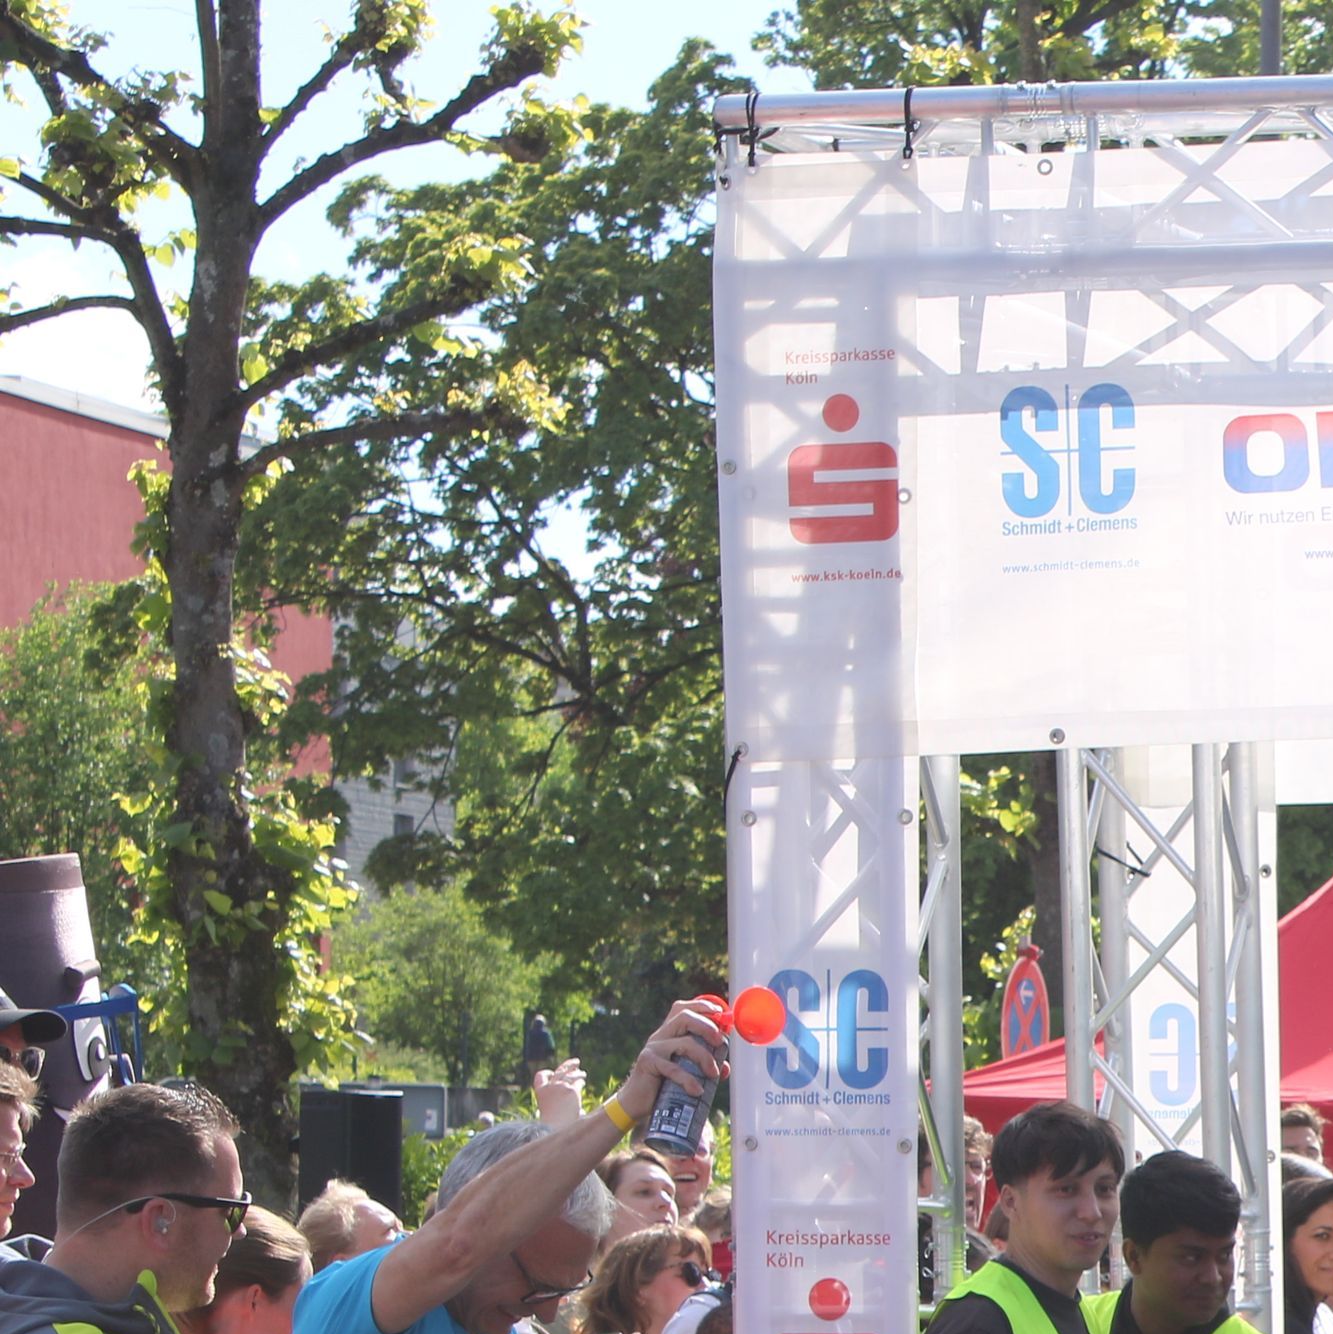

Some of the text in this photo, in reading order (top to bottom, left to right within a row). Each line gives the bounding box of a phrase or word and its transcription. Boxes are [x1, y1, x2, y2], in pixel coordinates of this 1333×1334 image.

[785, 346, 896, 367] Kreissparkasse
[785, 369, 819, 387] Köln
[1002, 518, 1062, 537] Schmidt
[1076, 514, 1138, 534] Clemens
[1225, 508, 1253, 526] Wir
[1257, 508, 1315, 525] nutzen
[1002, 556, 1140, 576] www.schmidt-clemens.de
[791, 568, 902, 585] www.ksk-koeln.de
[765, 1091, 820, 1105] Schmidt
[833, 1091, 891, 1105] Clemens
[765, 1127, 891, 1138] www.schmidt-clemens.de
[766, 1230, 891, 1248] Kreissparkasse
[766, 1251, 805, 1268] Köln
